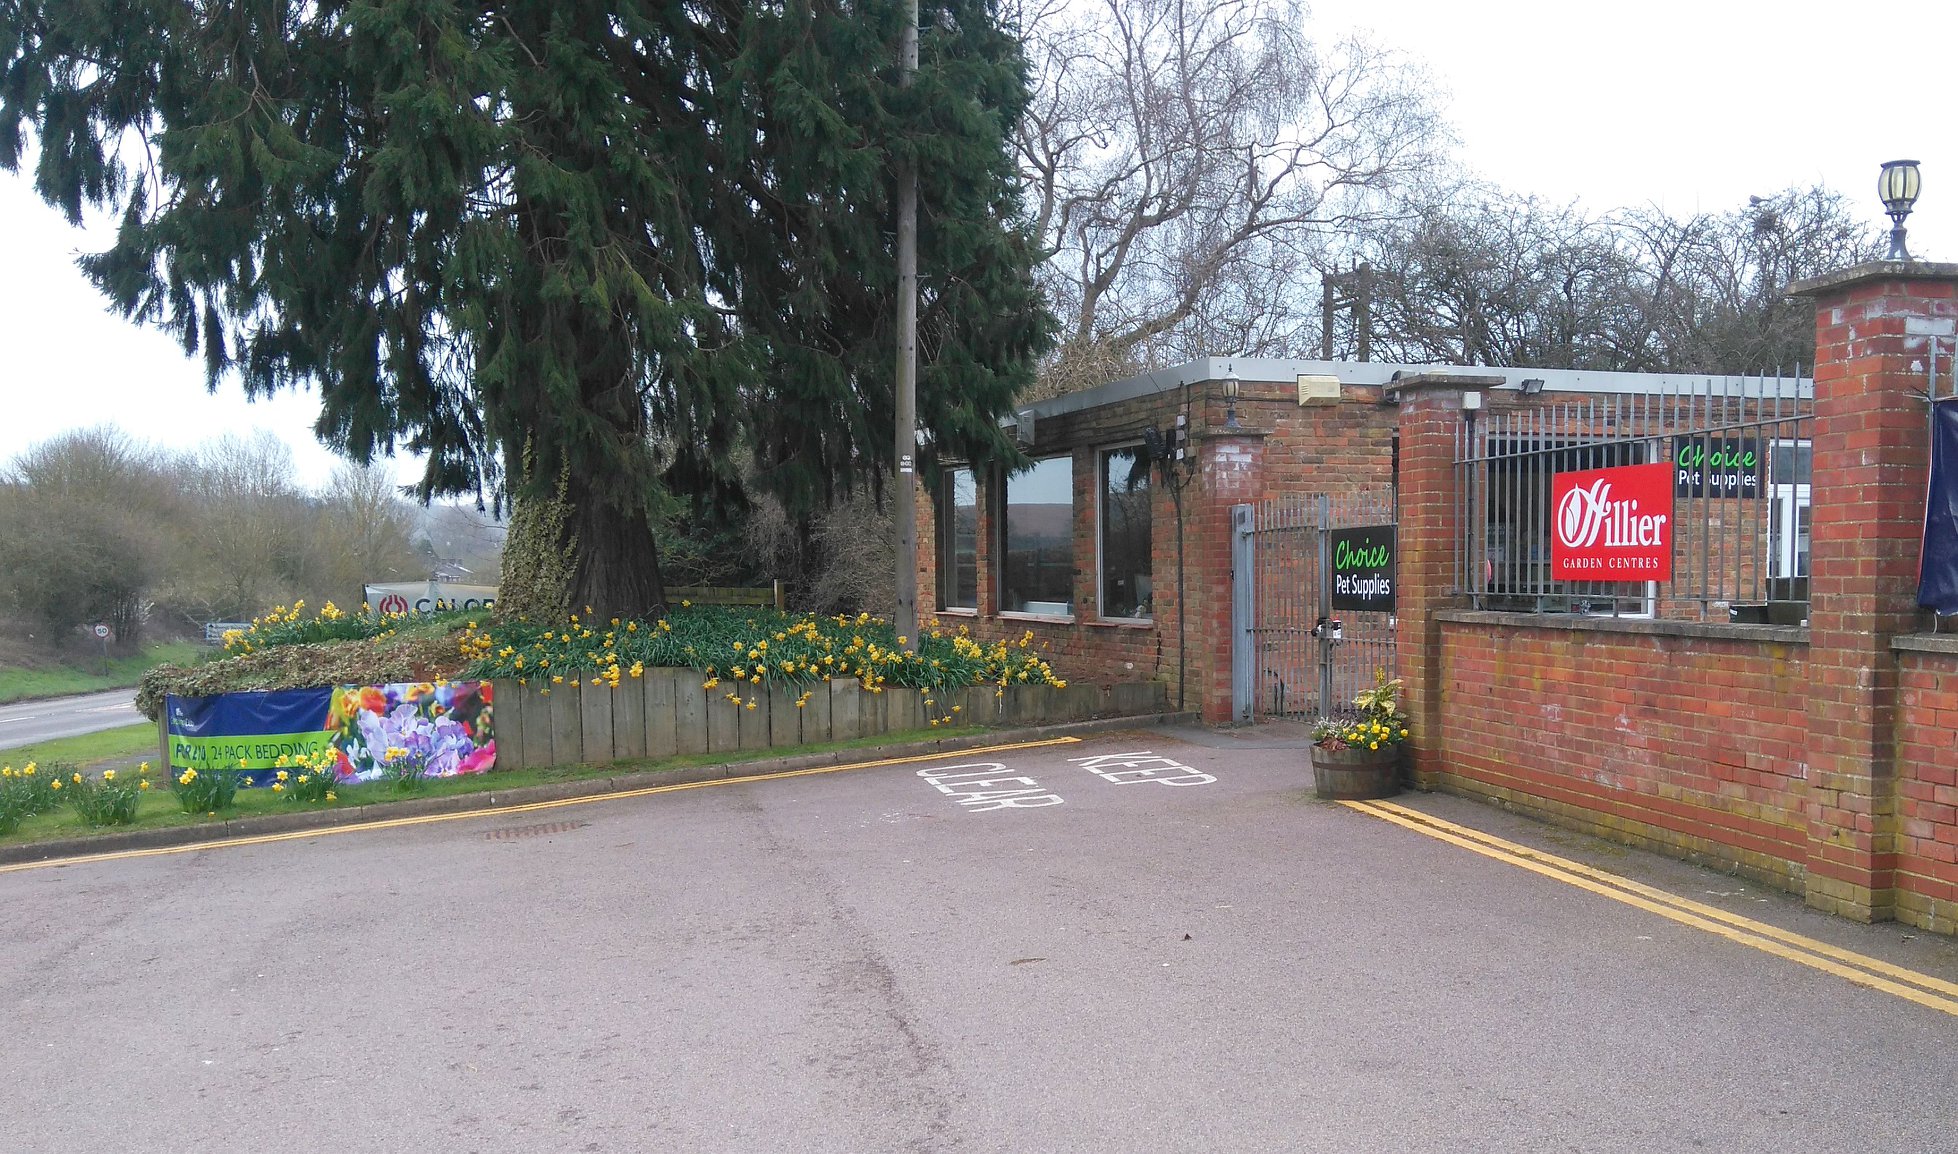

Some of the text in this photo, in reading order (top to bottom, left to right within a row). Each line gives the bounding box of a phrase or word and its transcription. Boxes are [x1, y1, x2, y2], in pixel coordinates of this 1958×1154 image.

[1678, 444, 1757, 468] Choice
[1678, 470, 1757, 490] Pet upplies
[1557, 478, 1667, 548] Hillier
[1336, 537, 1390, 570] Choice
[1563, 557, 1659, 569] GARDEN CENTRES
[1336, 573, 1390, 600] Pet Supplies
[211, 745, 222, 760] 24
[225, 744, 252, 760] PACK
[255, 741, 318, 760] BEDDING
[1066, 750, 1218, 788] KEEP
[916, 762, 1065, 813] CLEAR
